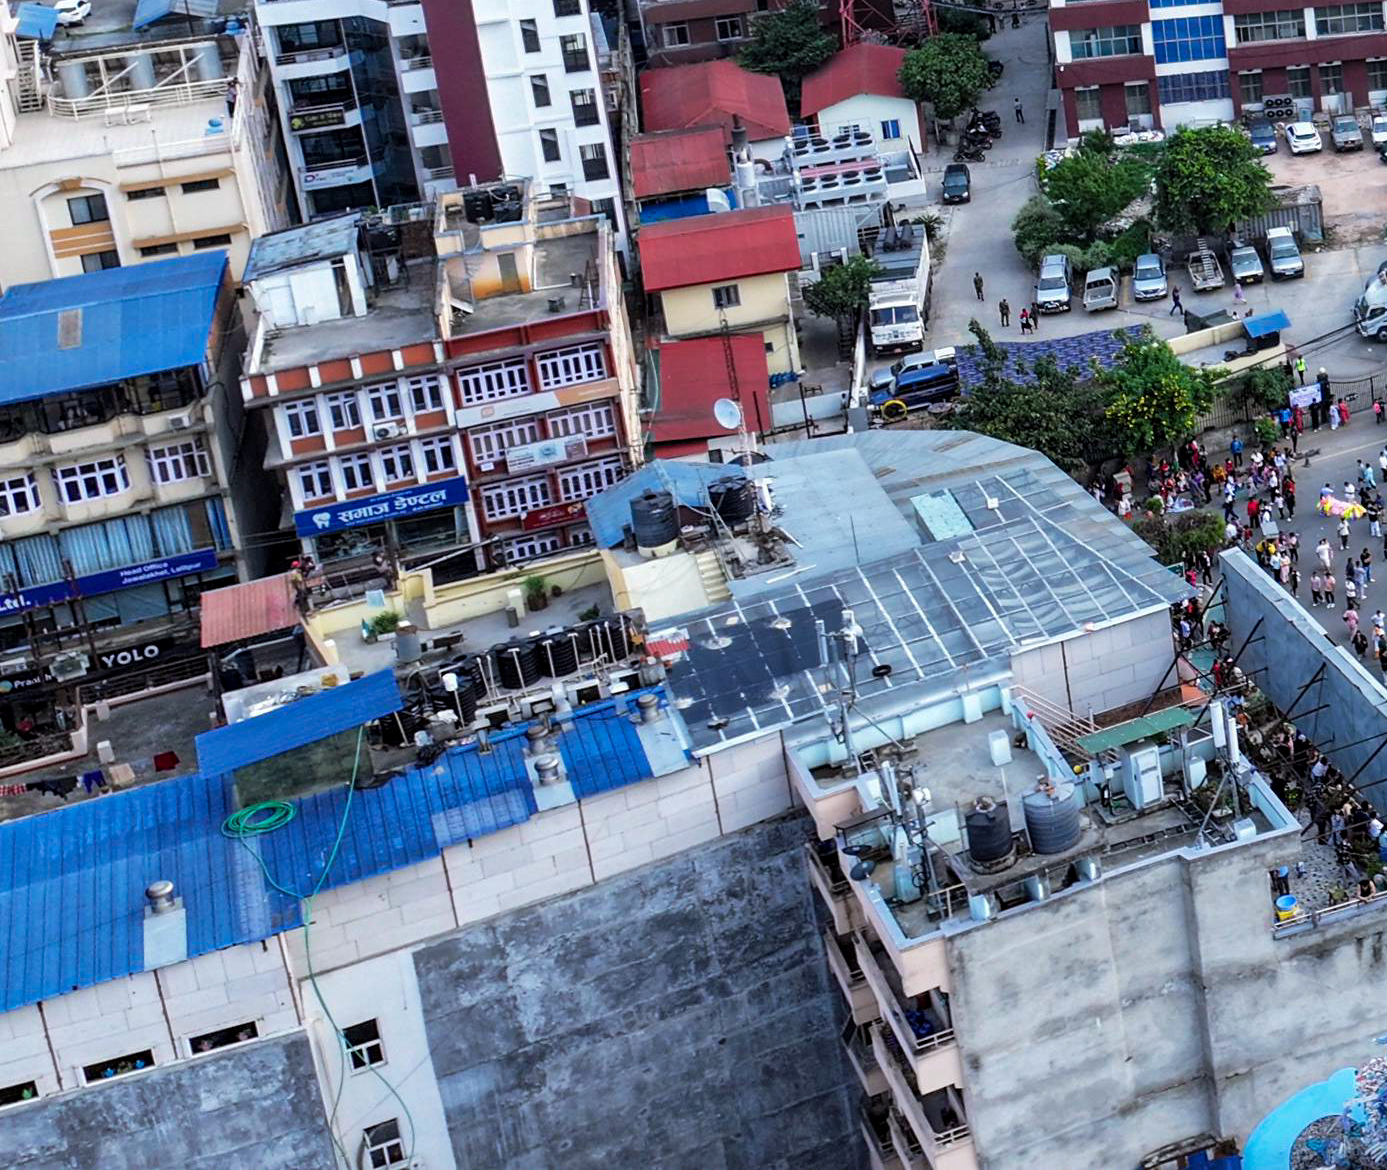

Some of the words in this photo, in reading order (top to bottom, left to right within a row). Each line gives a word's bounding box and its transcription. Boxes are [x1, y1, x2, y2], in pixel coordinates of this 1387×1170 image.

[337, 502, 390, 524] समाज
[394, 488, 447, 511] डेण्टल
[102, 644, 160, 668] YOLO
